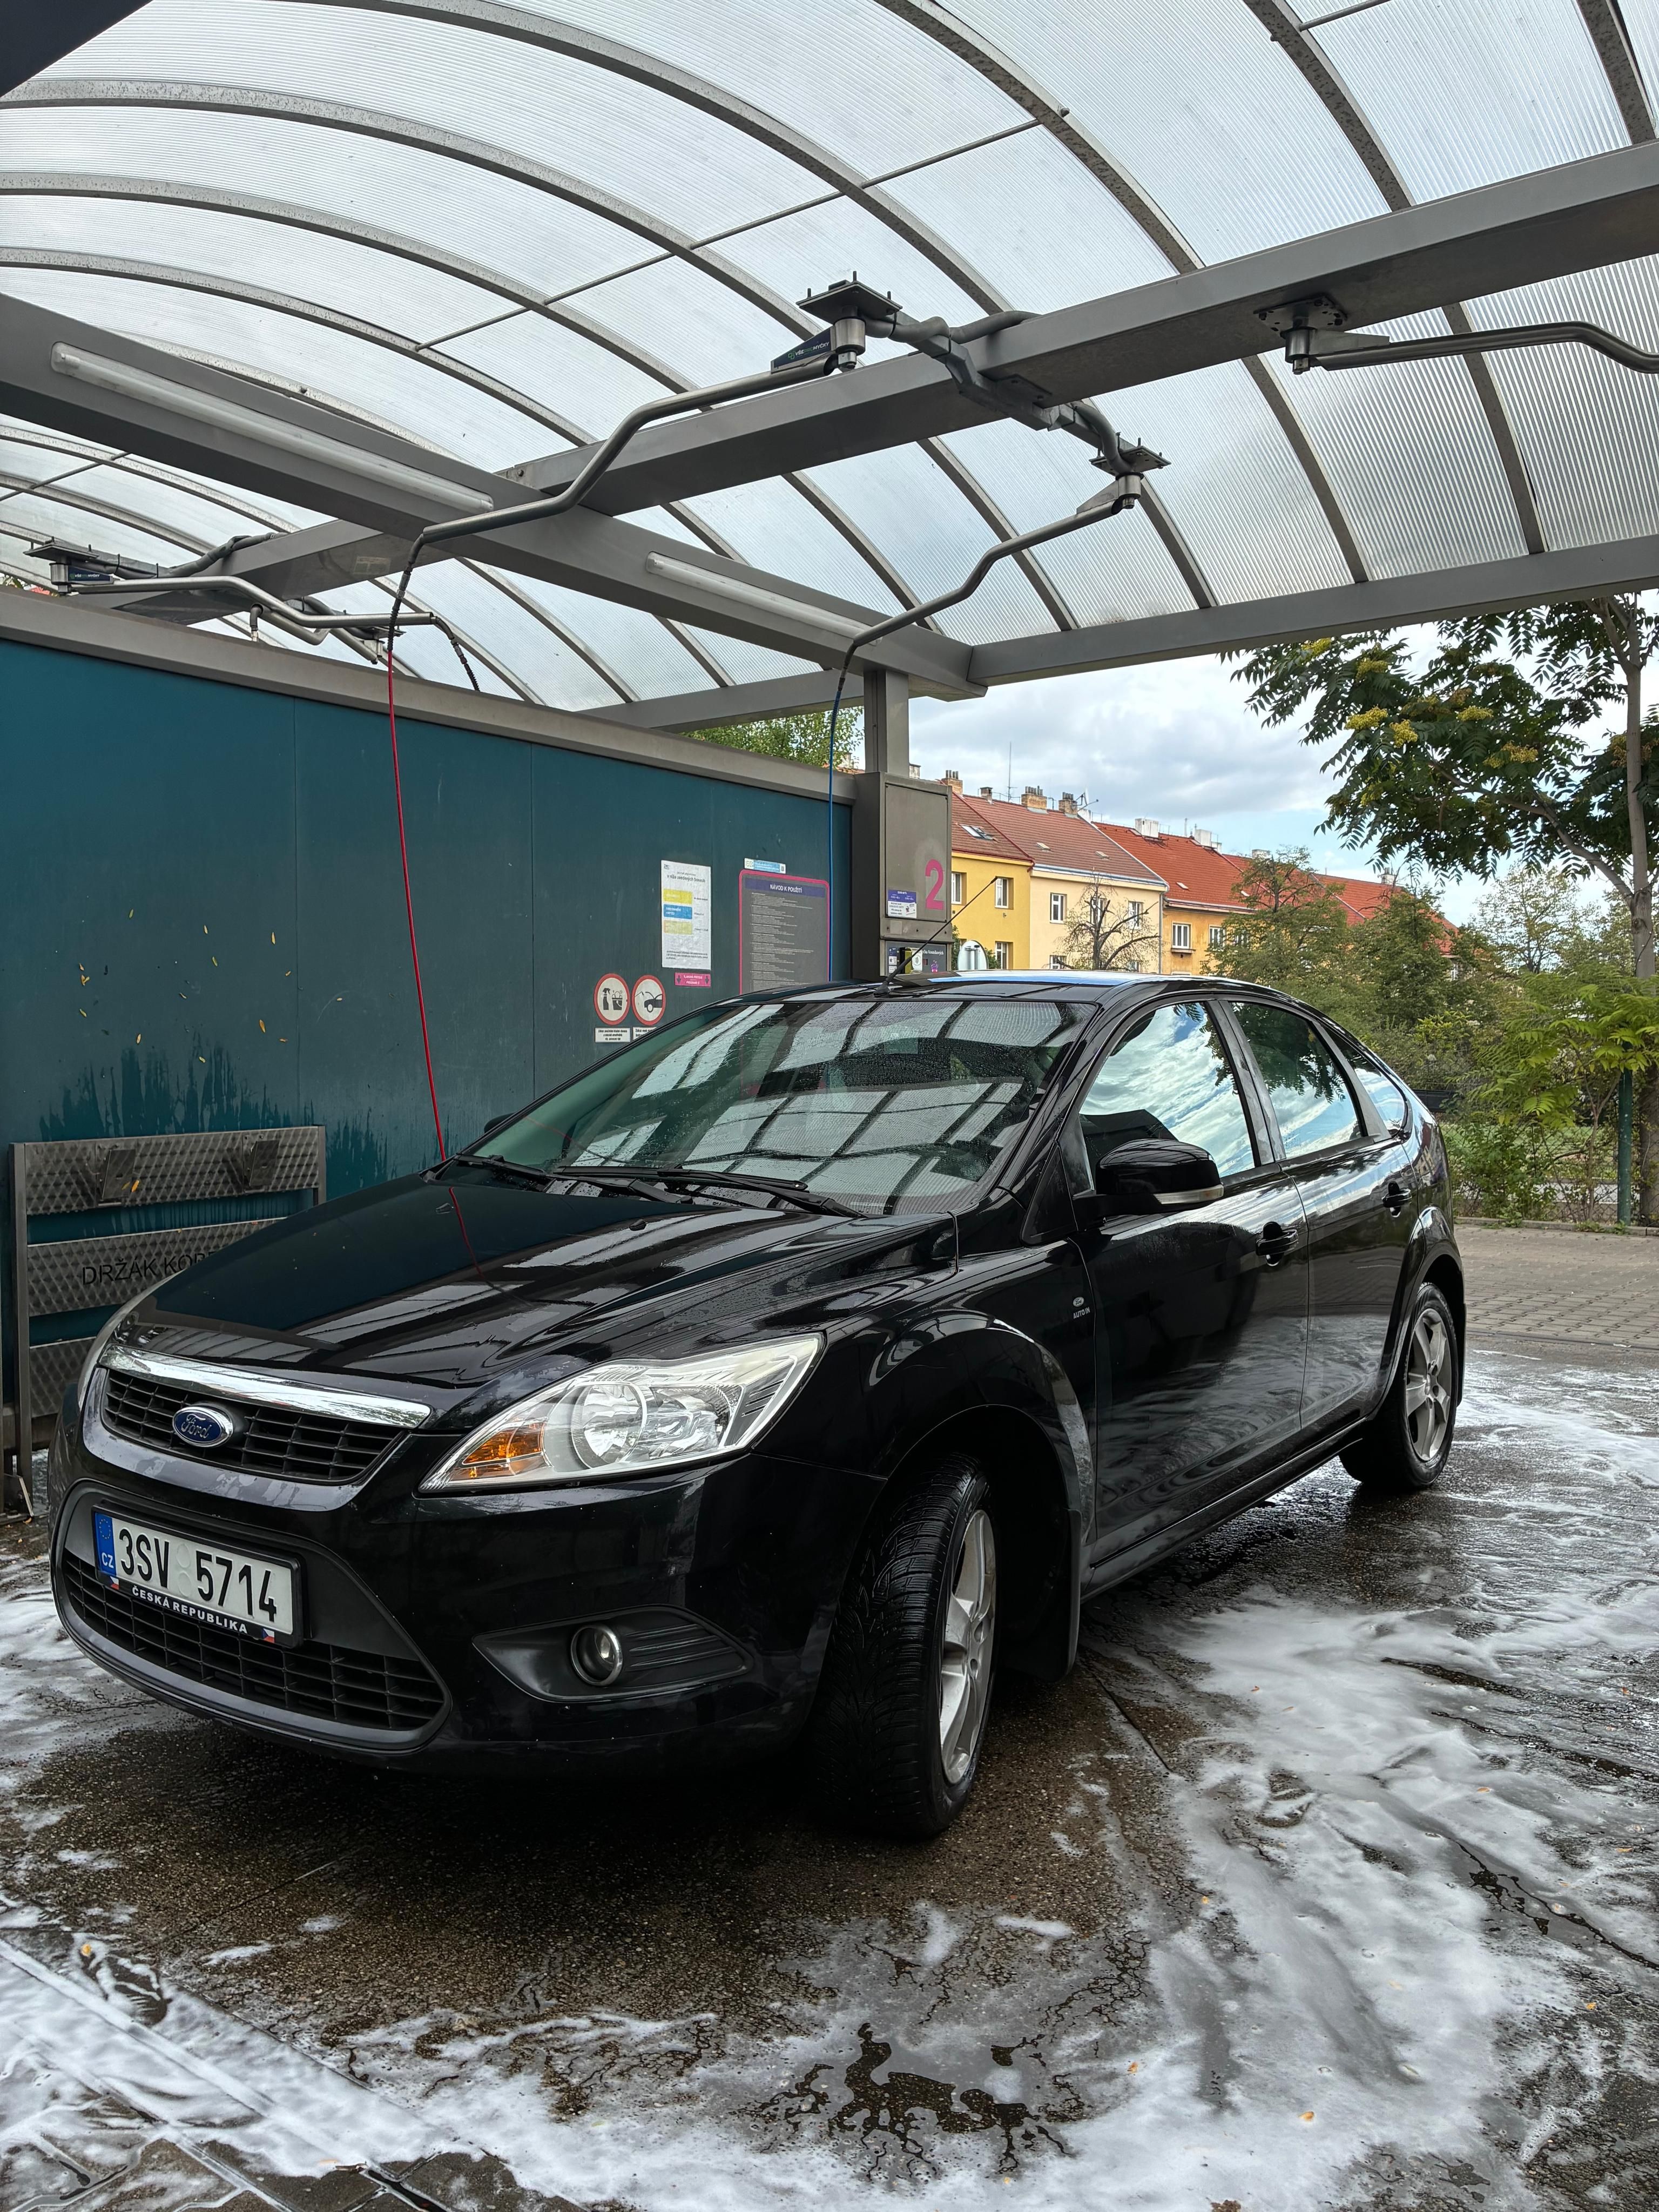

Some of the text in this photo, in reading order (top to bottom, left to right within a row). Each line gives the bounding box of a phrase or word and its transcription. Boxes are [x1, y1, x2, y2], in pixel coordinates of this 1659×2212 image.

[925, 859, 944, 910] 2
[83, 1256, 158, 1285] DRŽÁK
[181, 1413, 212, 1439] Ford
[102, 1552, 114, 1568] CZ
[119, 1528, 277, 1623] 3SV 5714
[132, 1585, 248, 1634] ČESKÁ REPUBLIKA
